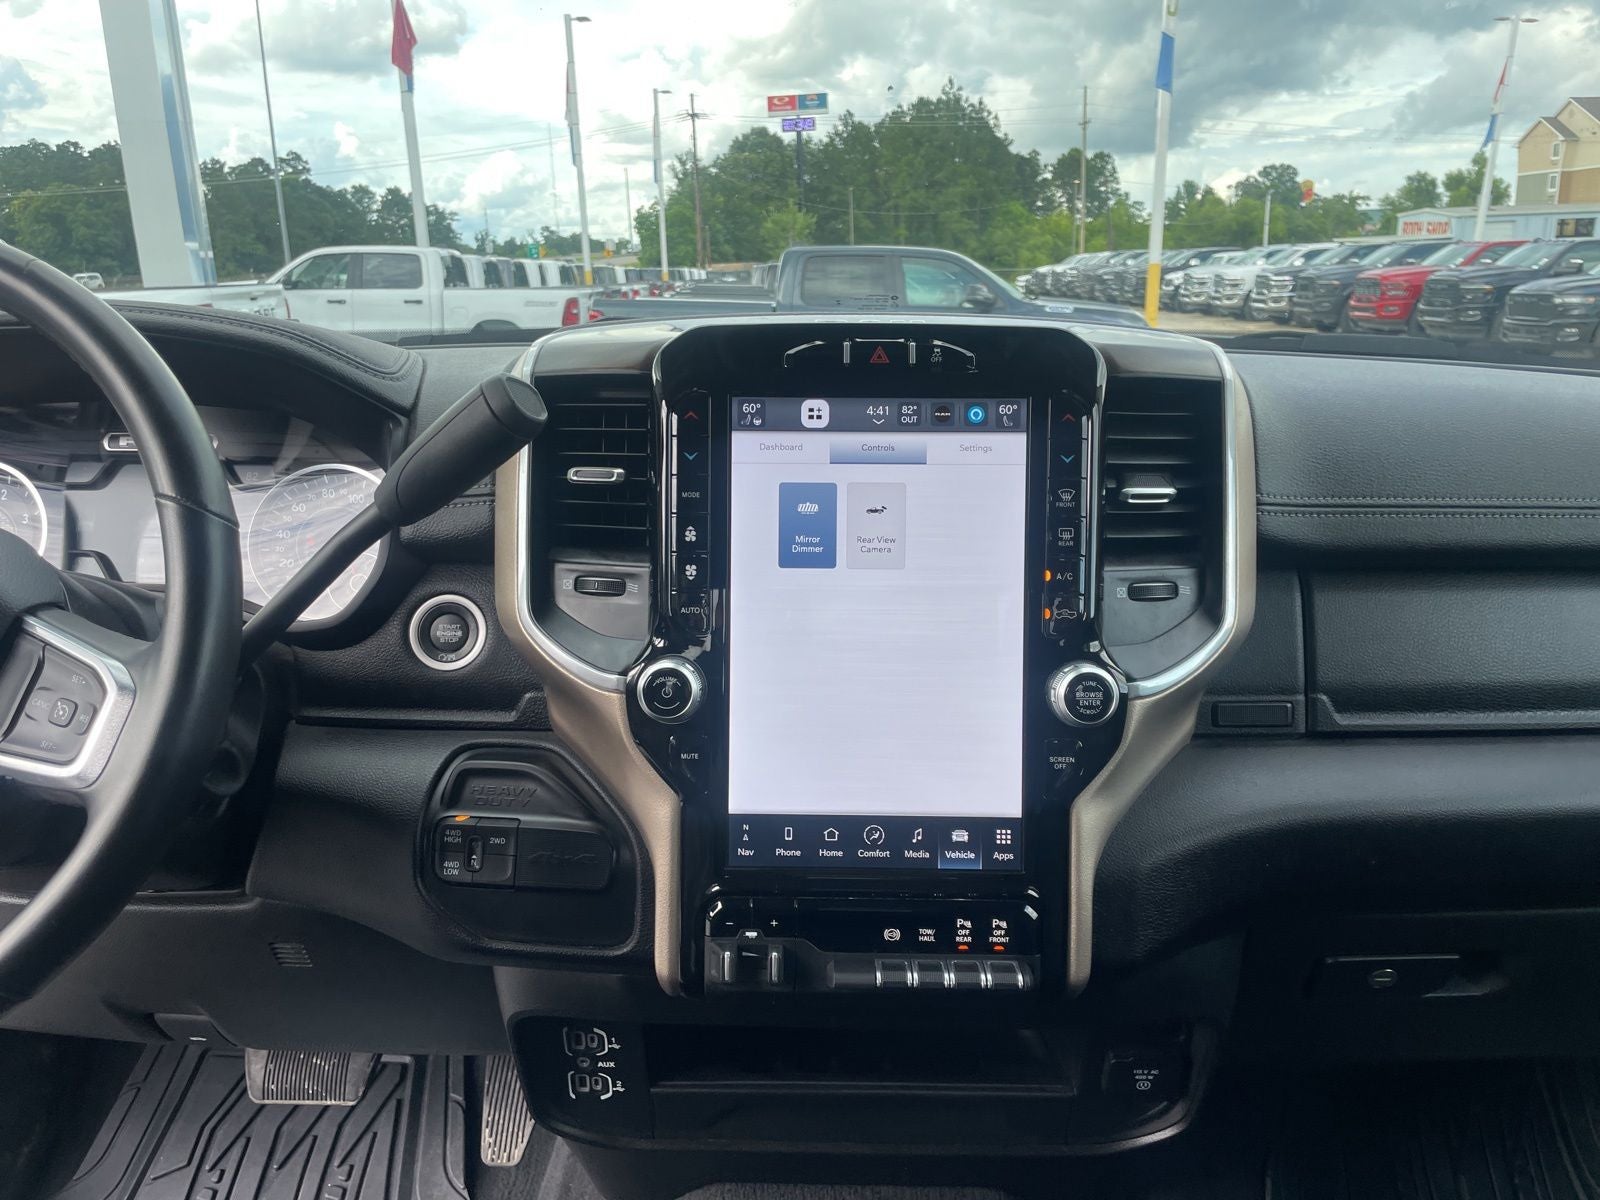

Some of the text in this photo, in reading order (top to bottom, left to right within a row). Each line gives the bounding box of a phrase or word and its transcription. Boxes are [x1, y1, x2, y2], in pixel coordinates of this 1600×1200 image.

[866, 405, 890, 416] 4:41
[901, 416, 918, 424] OUT
[759, 442, 803, 452] Dashboard
[861, 443, 895, 452] Controls
[959, 444, 993, 454] Settings
[1, 489, 8, 500] 2
[321, 488, 336, 498] 80
[291, 503, 306, 513] 60
[22, 513, 29, 524] 3
[276, 530, 291, 539] 40
[795, 535, 821, 544] Mirror
[856, 535, 896, 544] Rear View
[792, 544, 824, 553] Dimmer
[860, 545, 892, 553] Camera
[280, 559, 295, 568] 20
[1056, 572, 1073, 580] A/C
[680, 606, 700, 614] AUTO
[471, 784, 538, 798] HEAVY
[445, 829, 462, 837] 4WD
[444, 836, 462, 844] HIGH
[489, 837, 506, 845] 2WD
[737, 847, 755, 857] Nav
[775, 848, 801, 858] Phone
[819, 849, 844, 858] Home
[858, 849, 890, 859] Comfort
[904, 850, 930, 859] Media
[945, 851, 976, 860] Vehicle
[993, 852, 1014, 862] Apps
[443, 868, 460, 876] LOW
[919, 928, 936, 936] TOW/
